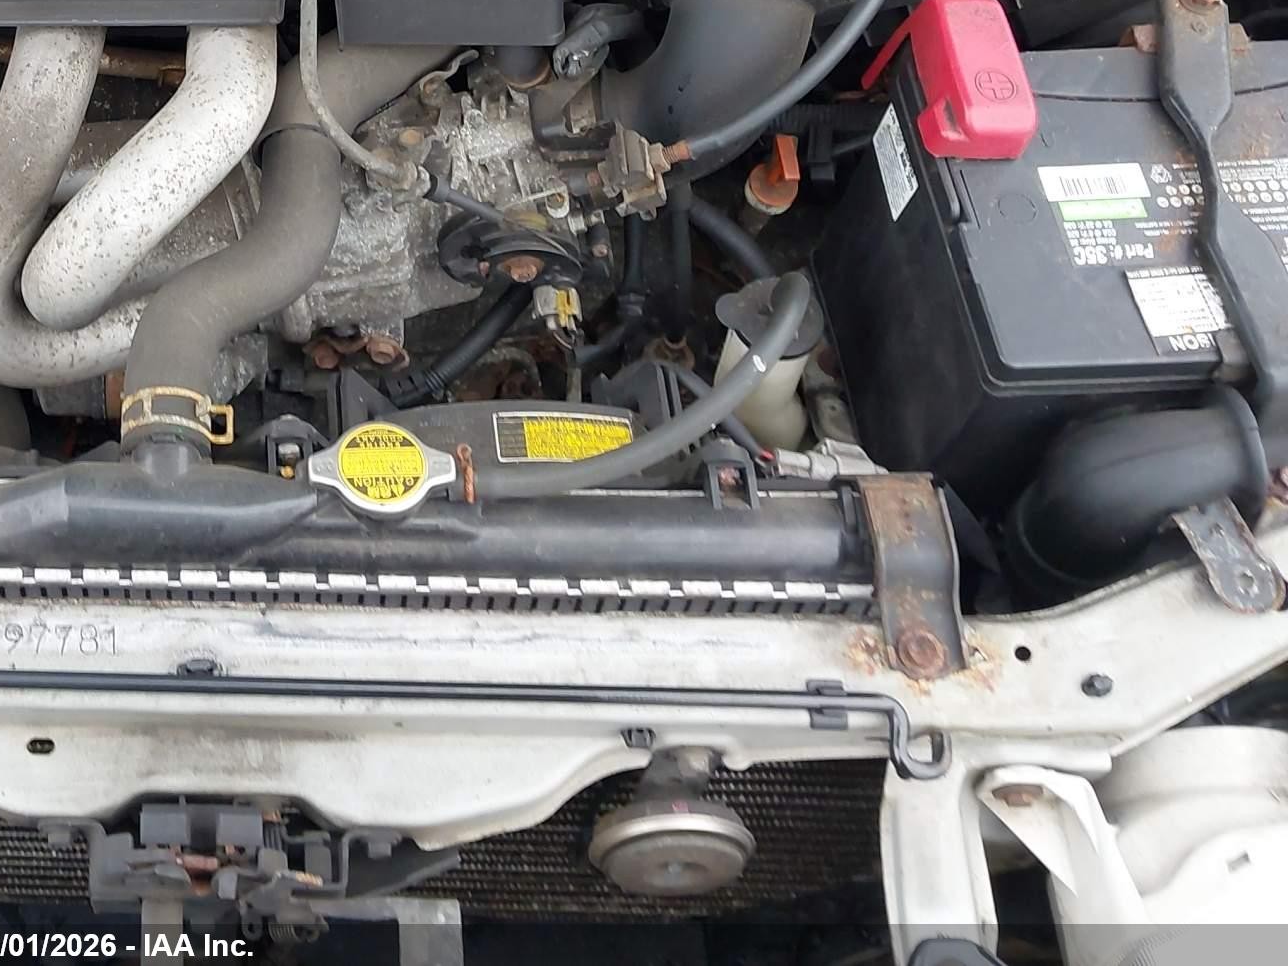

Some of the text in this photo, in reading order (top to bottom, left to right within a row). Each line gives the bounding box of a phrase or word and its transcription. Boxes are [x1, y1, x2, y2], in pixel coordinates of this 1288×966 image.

[1073, 245, 1108, 265] 35C
[1124, 242, 1155, 259] Part
[353, 475, 415, 488] CAUTION
[4, 622, 117, 656] 97781
